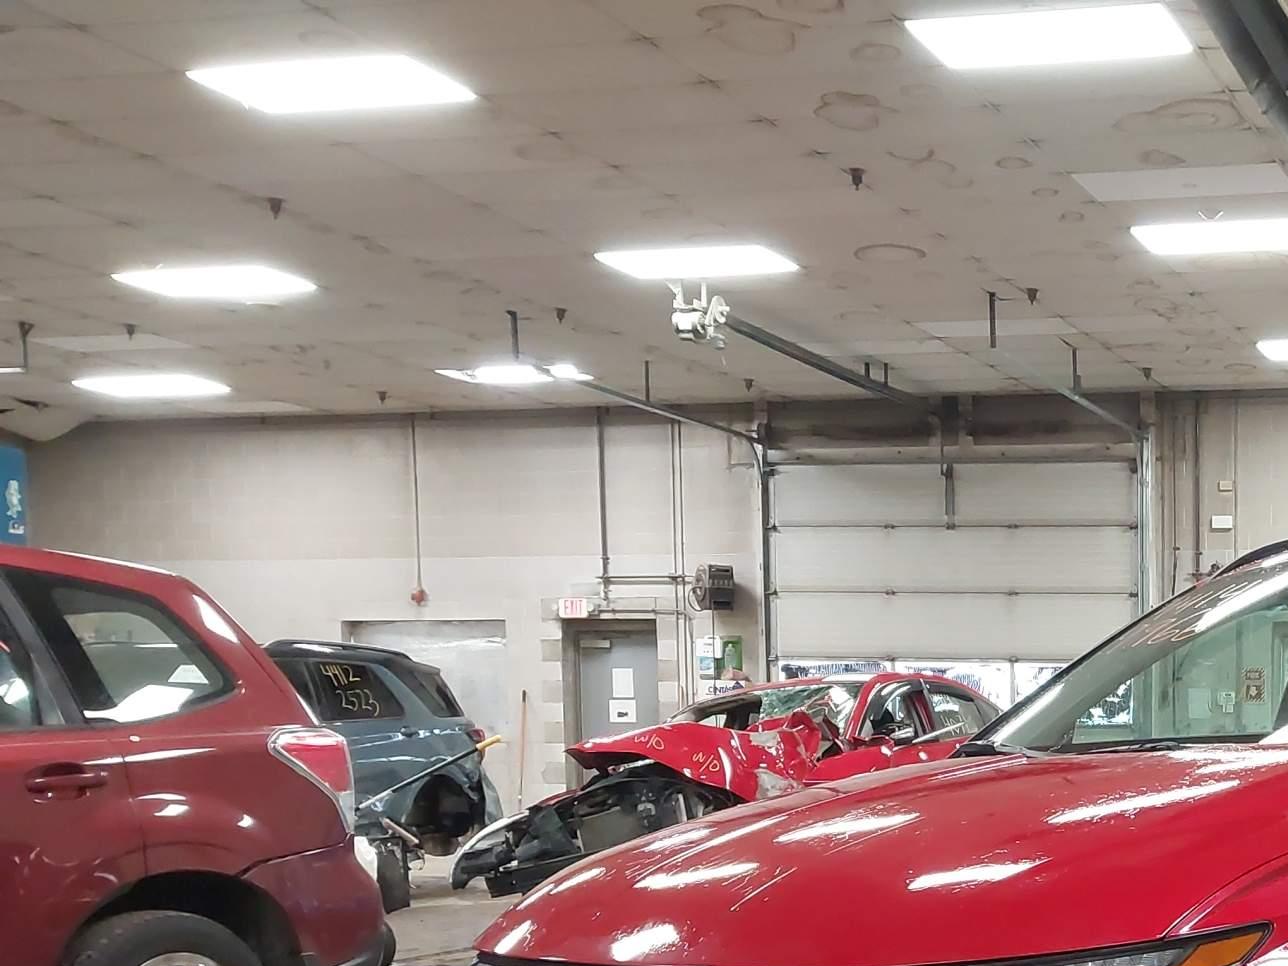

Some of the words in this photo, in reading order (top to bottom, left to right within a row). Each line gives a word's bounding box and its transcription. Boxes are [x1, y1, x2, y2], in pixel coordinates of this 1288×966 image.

[564, 599, 583, 617] EXIT
[319, 663, 362, 687] 4412
[335, 689, 380, 718] 2523
